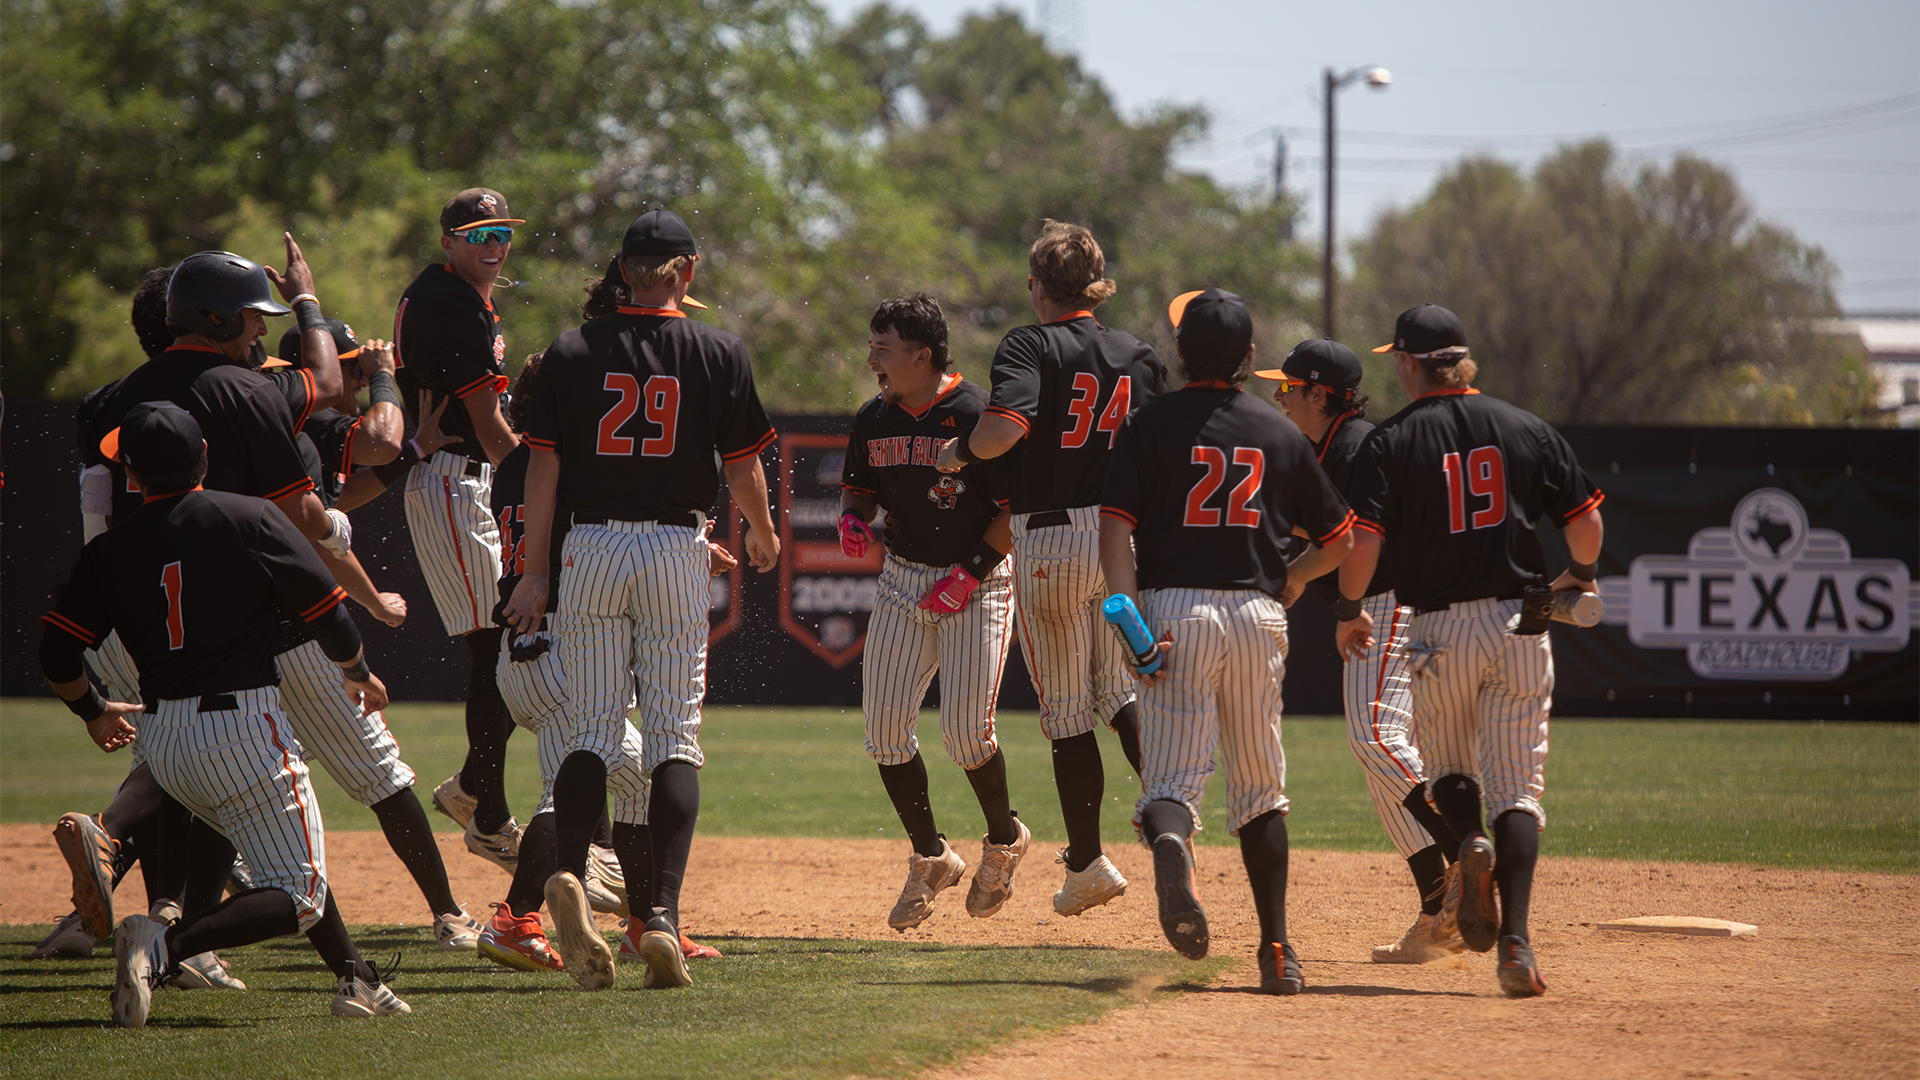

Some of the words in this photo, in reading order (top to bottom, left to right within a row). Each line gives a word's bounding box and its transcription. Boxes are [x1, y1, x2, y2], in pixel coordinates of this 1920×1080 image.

[596, 372, 681, 457] 29
[1061, 372, 1131, 450] 34
[867, 436, 911, 467] FIGHTING
[1183, 445, 1265, 528] 22
[1442, 445, 1507, 534] 19
[160, 560, 185, 650] 1
[1649, 571, 1896, 634] TEXAS
[1696, 639, 1845, 670] ROADHOUSE
